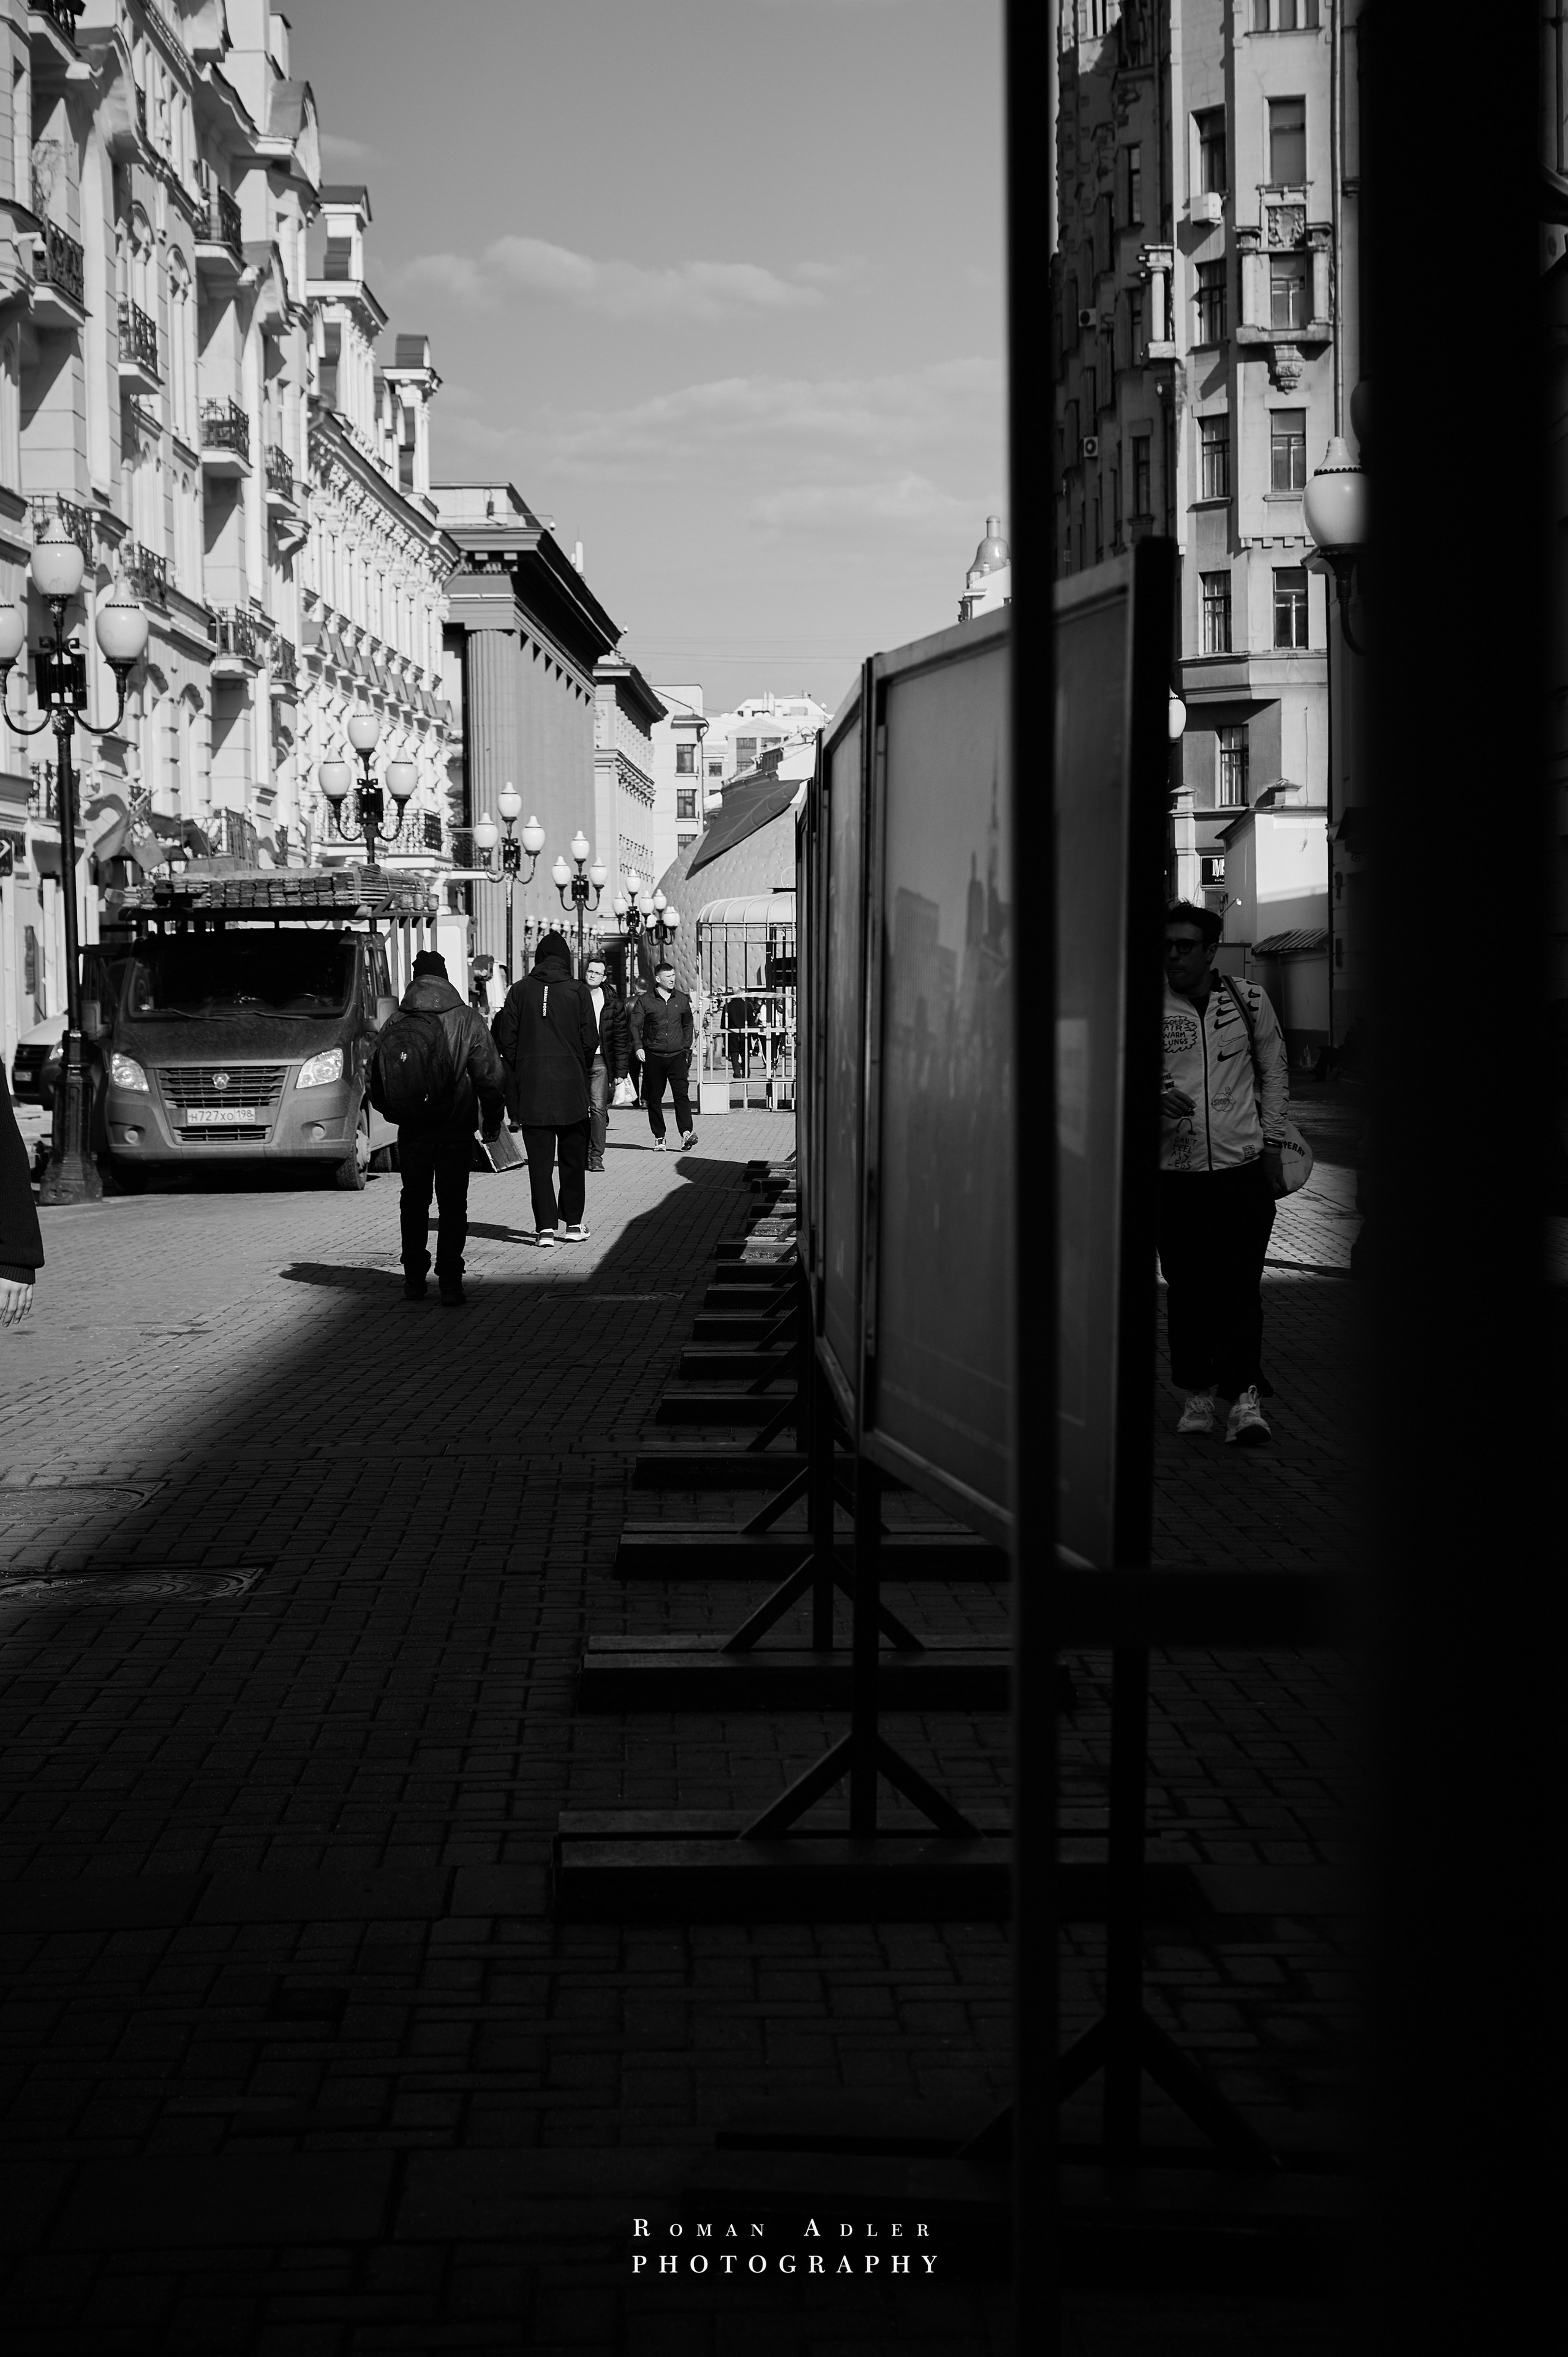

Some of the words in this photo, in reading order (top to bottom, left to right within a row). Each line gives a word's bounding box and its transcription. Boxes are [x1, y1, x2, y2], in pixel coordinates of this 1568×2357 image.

[1213, 1098, 1229, 1106] STOP
[1173, 1143, 1192, 1154] FEEL
[1281, 1141, 1305, 1156] PERRY
